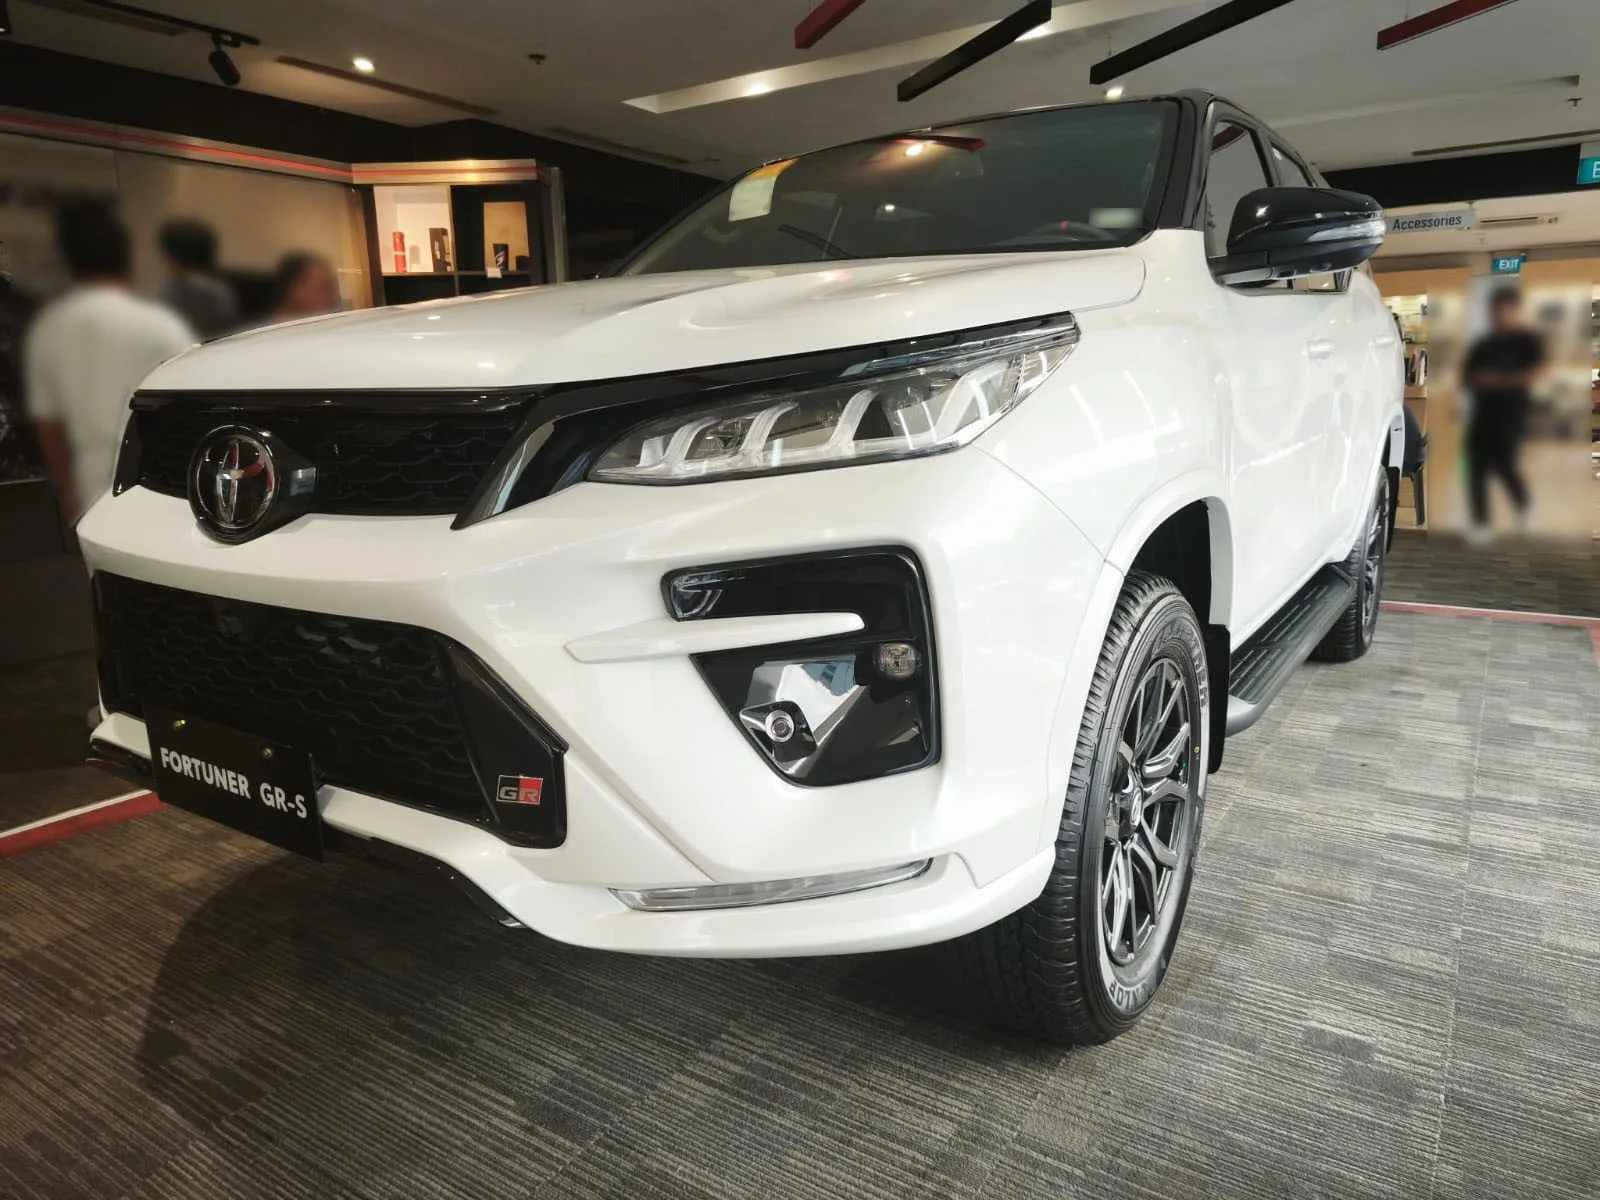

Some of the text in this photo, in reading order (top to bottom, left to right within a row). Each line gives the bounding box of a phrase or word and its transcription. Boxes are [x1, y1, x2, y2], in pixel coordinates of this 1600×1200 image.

[1392, 214, 1463, 231] Accessories
[1499, 258, 1520, 270] EXIT
[160, 746, 308, 819] FORTUNER GR-S
[499, 786, 540, 803] GR
